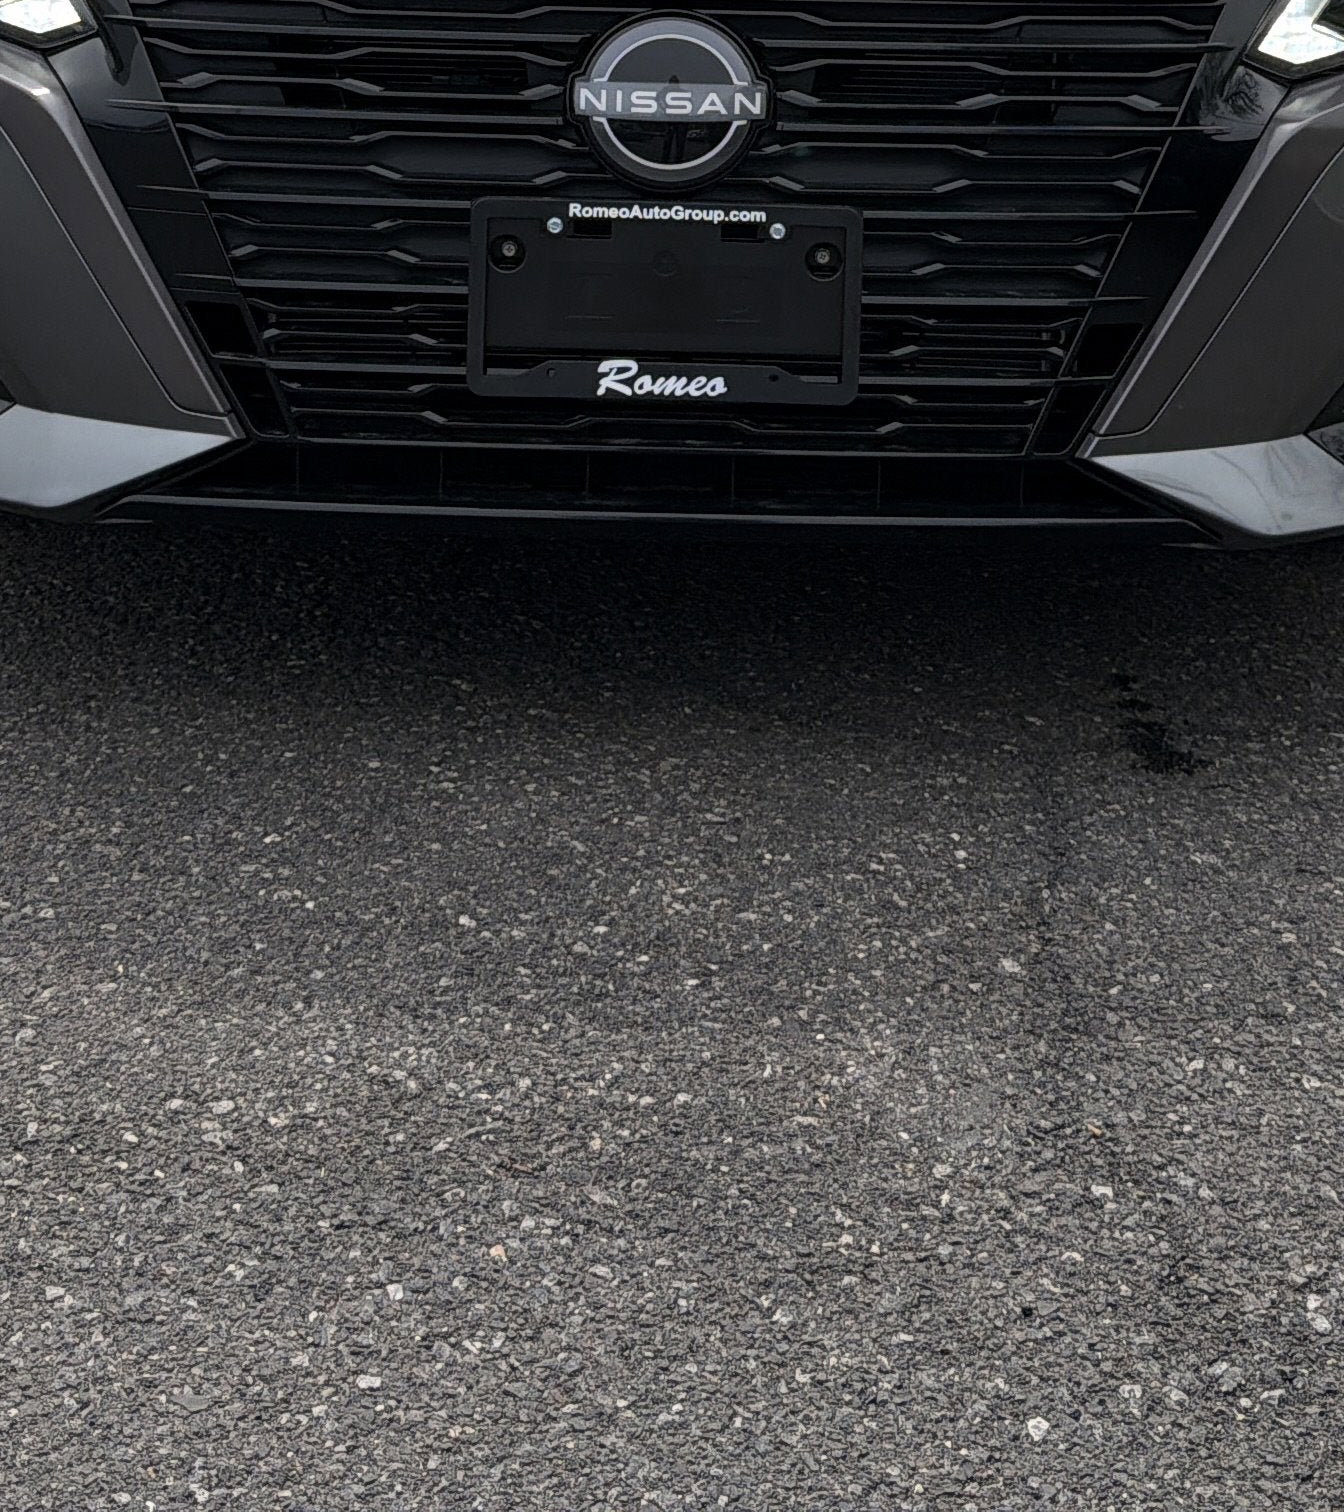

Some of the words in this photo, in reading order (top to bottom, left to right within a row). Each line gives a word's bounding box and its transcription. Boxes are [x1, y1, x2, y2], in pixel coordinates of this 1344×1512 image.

[579, 88, 762, 115] NISSAN
[568, 202, 766, 223] RomeoAutoGroup.com
[596, 359, 728, 396] Romeo
